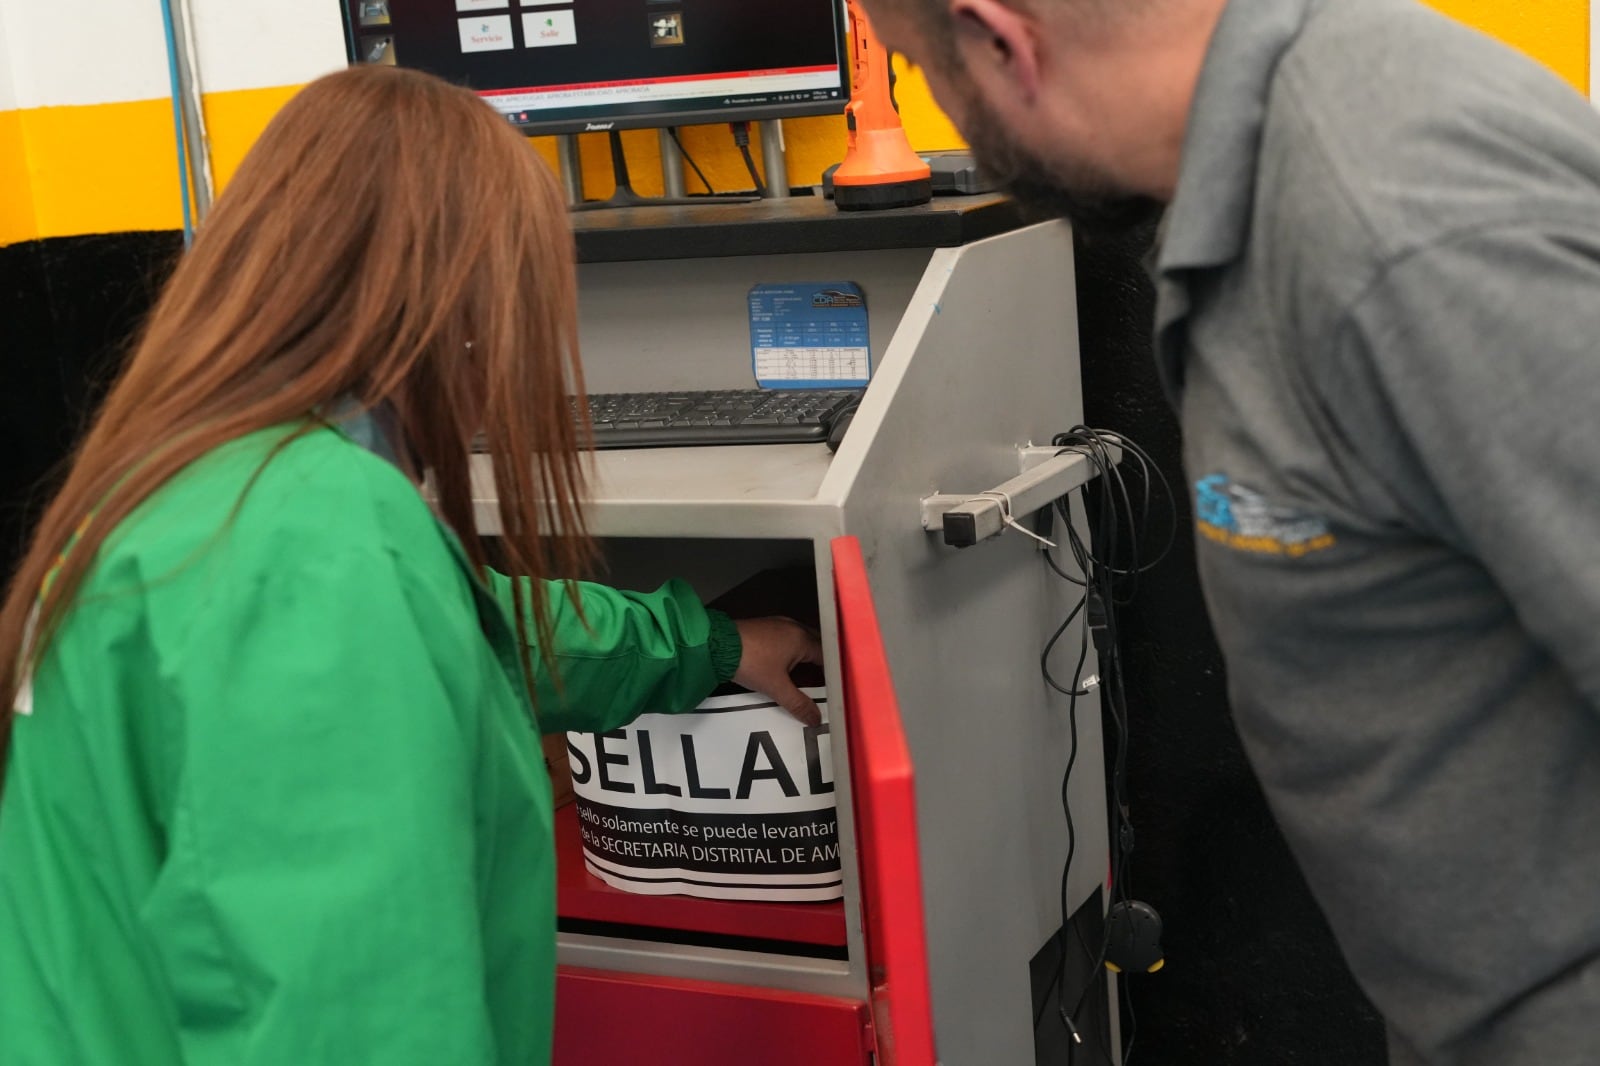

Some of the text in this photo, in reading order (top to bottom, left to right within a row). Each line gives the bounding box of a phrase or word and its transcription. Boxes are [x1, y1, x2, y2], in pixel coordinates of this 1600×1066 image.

[470, 33, 503, 45] Servicio
[602, 815, 679, 834] solamente
[682, 824, 699, 837] se
[703, 823, 758, 841] puede
[762, 820, 836, 839] levantar
[591, 831, 600, 847] la
[601, 836, 689, 860] SECRETARIA
[691, 846, 777, 864] DISTRITAL
[781, 847, 806, 863] DE
